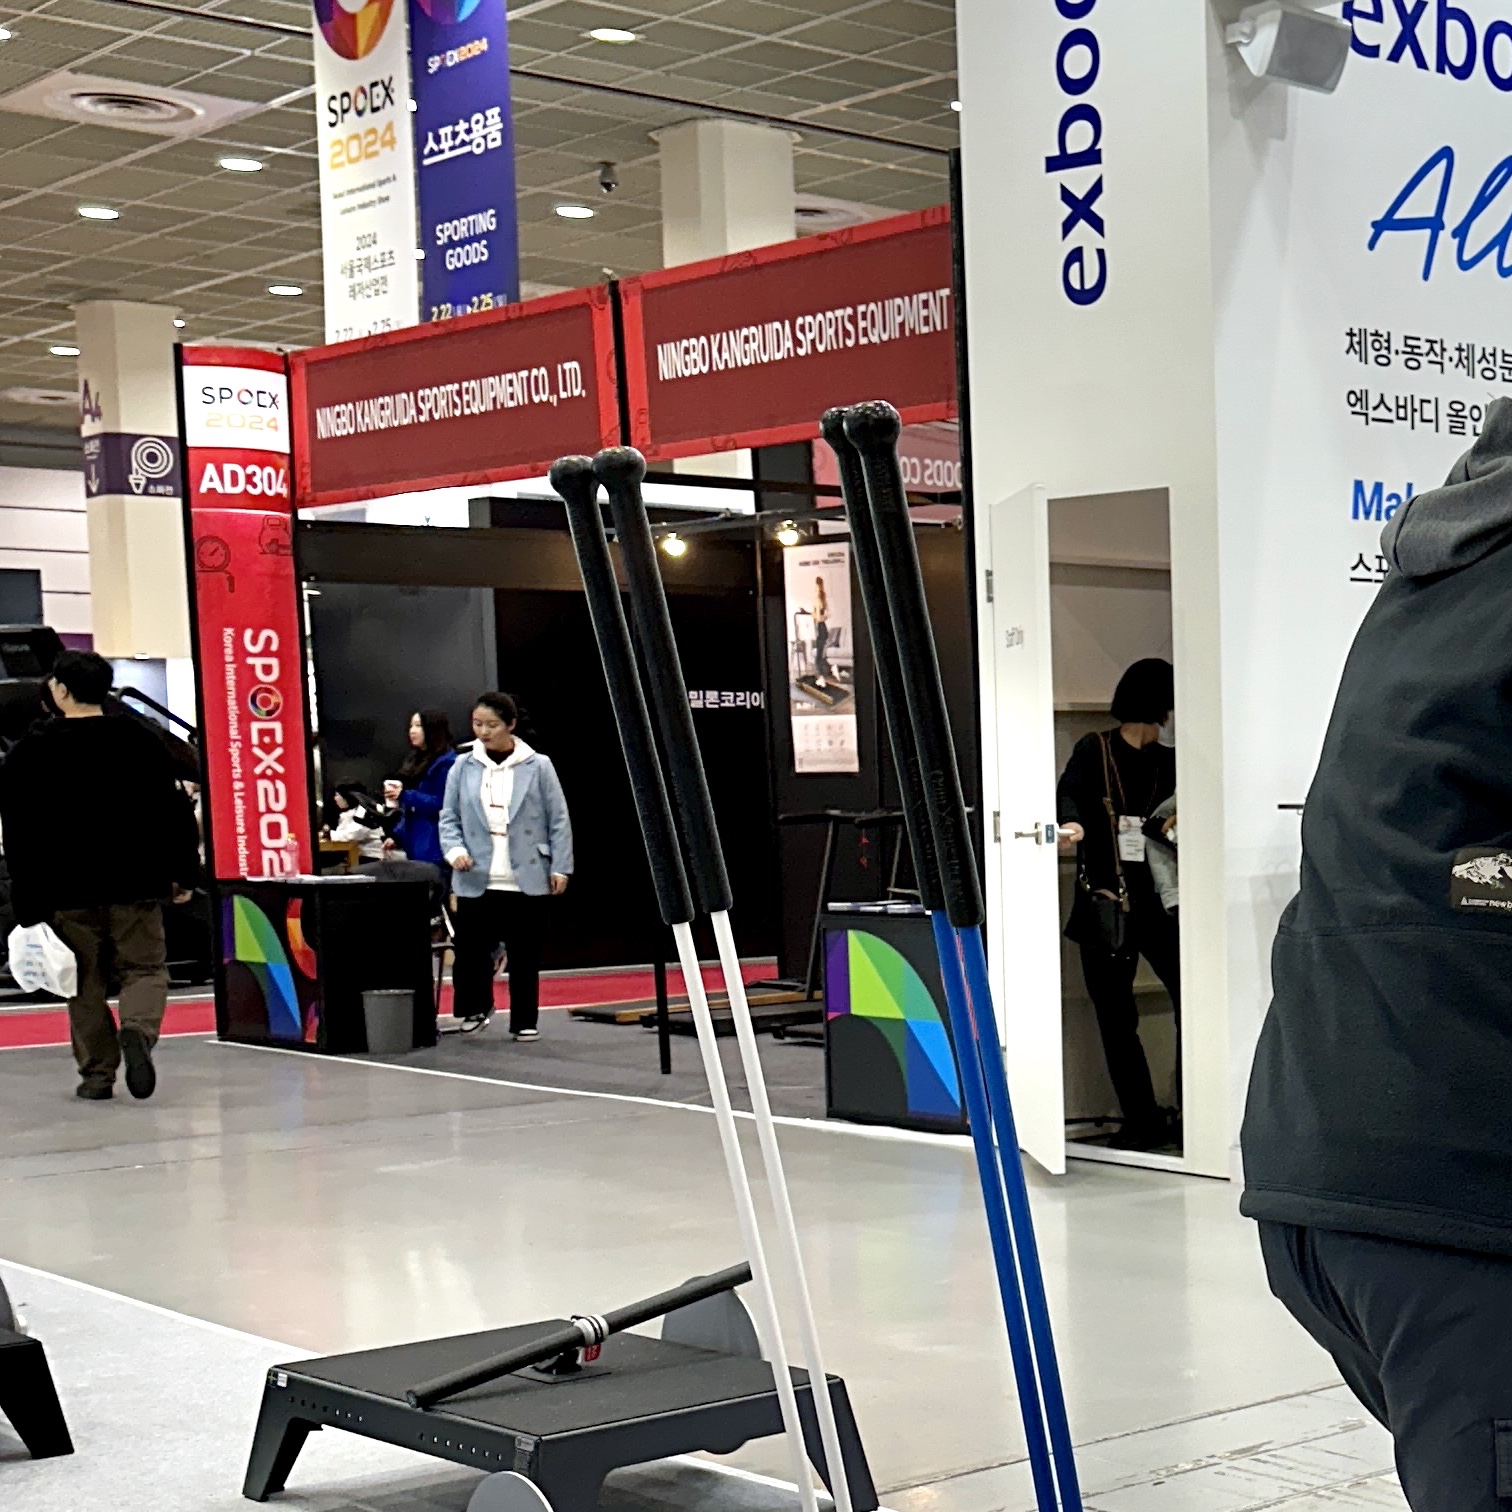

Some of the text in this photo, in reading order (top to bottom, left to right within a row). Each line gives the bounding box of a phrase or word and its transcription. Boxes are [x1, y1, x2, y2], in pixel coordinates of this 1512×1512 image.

[327, 75, 395, 128] SPOEX
[329, 120, 396, 170] 2024
[422, 106, 503, 166] 스포츠용품
[1044, 0, 1107, 306] exbo
[435, 208, 497, 245] SPORTING
[445, 240, 489, 271] GOODS
[656, 287, 951, 381] NINGBO KANGRUIDA SPORTS EQUIPMENT
[201, 386, 280, 410] SPOEX
[316, 402, 356, 439] NINGBO
[355, 391, 418, 434] KANGRUIDA
[417, 382, 462, 423] SPORTS
[461, 370, 530, 416] EQUIPMENT
[557, 360, 586, 400] LTD.
[1346, 388, 1440, 434] 엑스바디
[205, 412, 280, 433] 2024
[199, 463, 288, 498] AD304
[222, 627, 235, 662] Korea
[225, 663, 242, 740] International
[229, 740, 243, 779] Sports
[233, 791, 247, 834] Leisure
